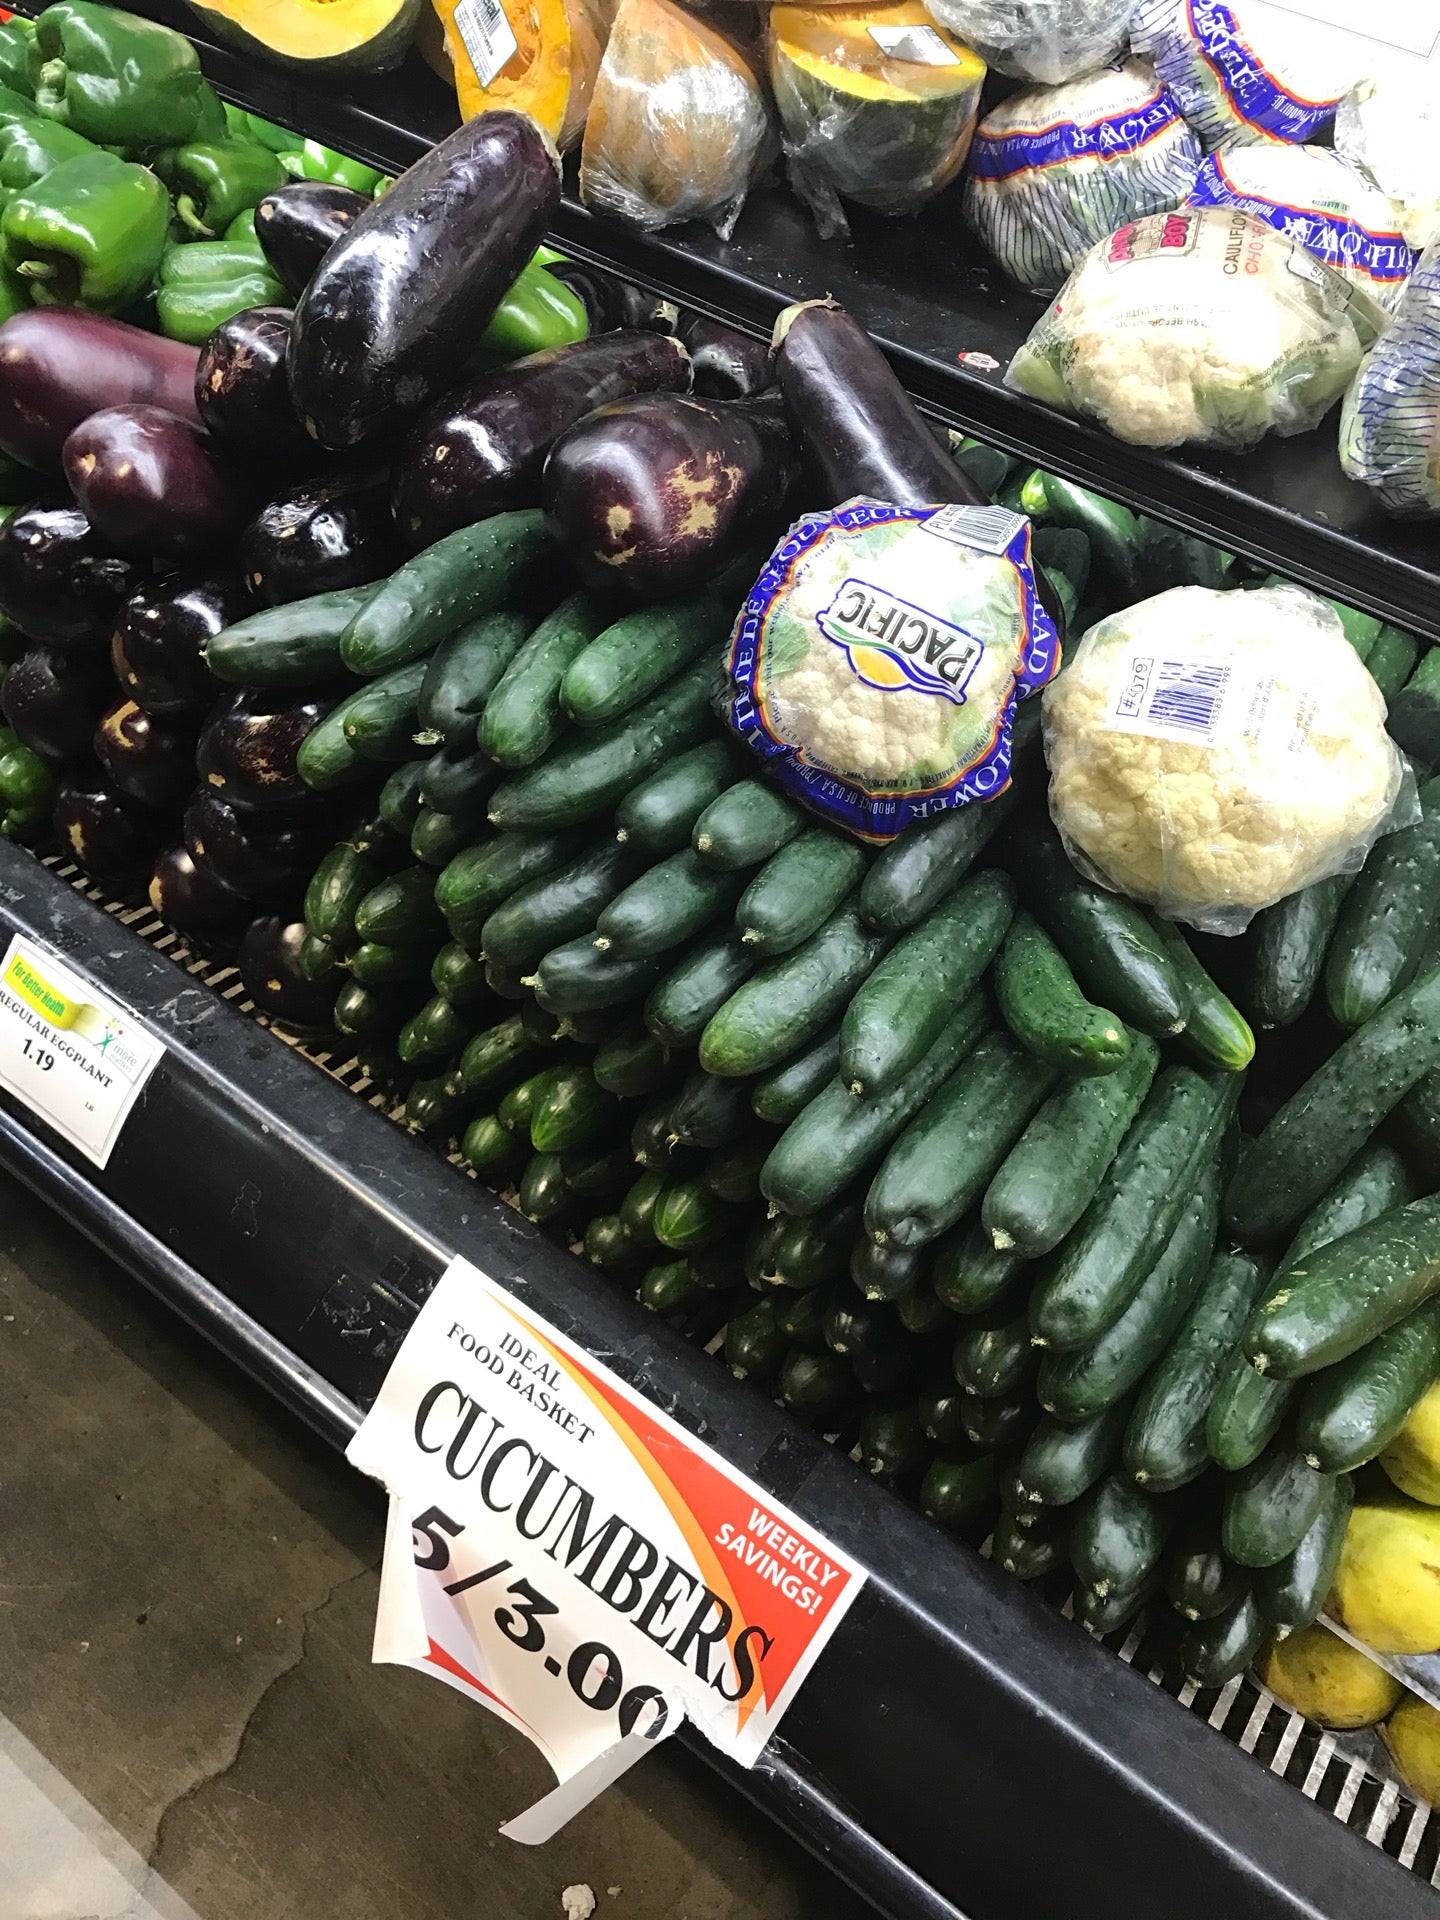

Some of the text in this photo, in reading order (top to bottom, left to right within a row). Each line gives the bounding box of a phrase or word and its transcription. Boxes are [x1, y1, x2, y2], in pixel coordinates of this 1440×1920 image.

[1160, 213, 1192, 248] BOY
[742, 599, 765, 642] DE
[837, 587, 977, 688] PACIFIC
[821, 777, 846, 800] U.S.A.
[845, 791, 858, 805] OF
[859, 796, 896, 815] PRODUCE
[12, 961, 65, 1017] For Better Health
[0, 990, 113, 1089] REGULAR EGGPLANT
[22, 1038, 55, 1072] 1.19
[112, 1043, 137, 1067] more
[84, 1100, 94, 1112] LB
[447, 1322, 595, 1444] FOOD BASKET
[499, 1332, 561, 1392] IDEAL
[414, 1380, 775, 1702] CUCUMBERS
[747, 1507, 840, 1588] WEEKLY
[714, 1523, 823, 1615] SAVINGS!
